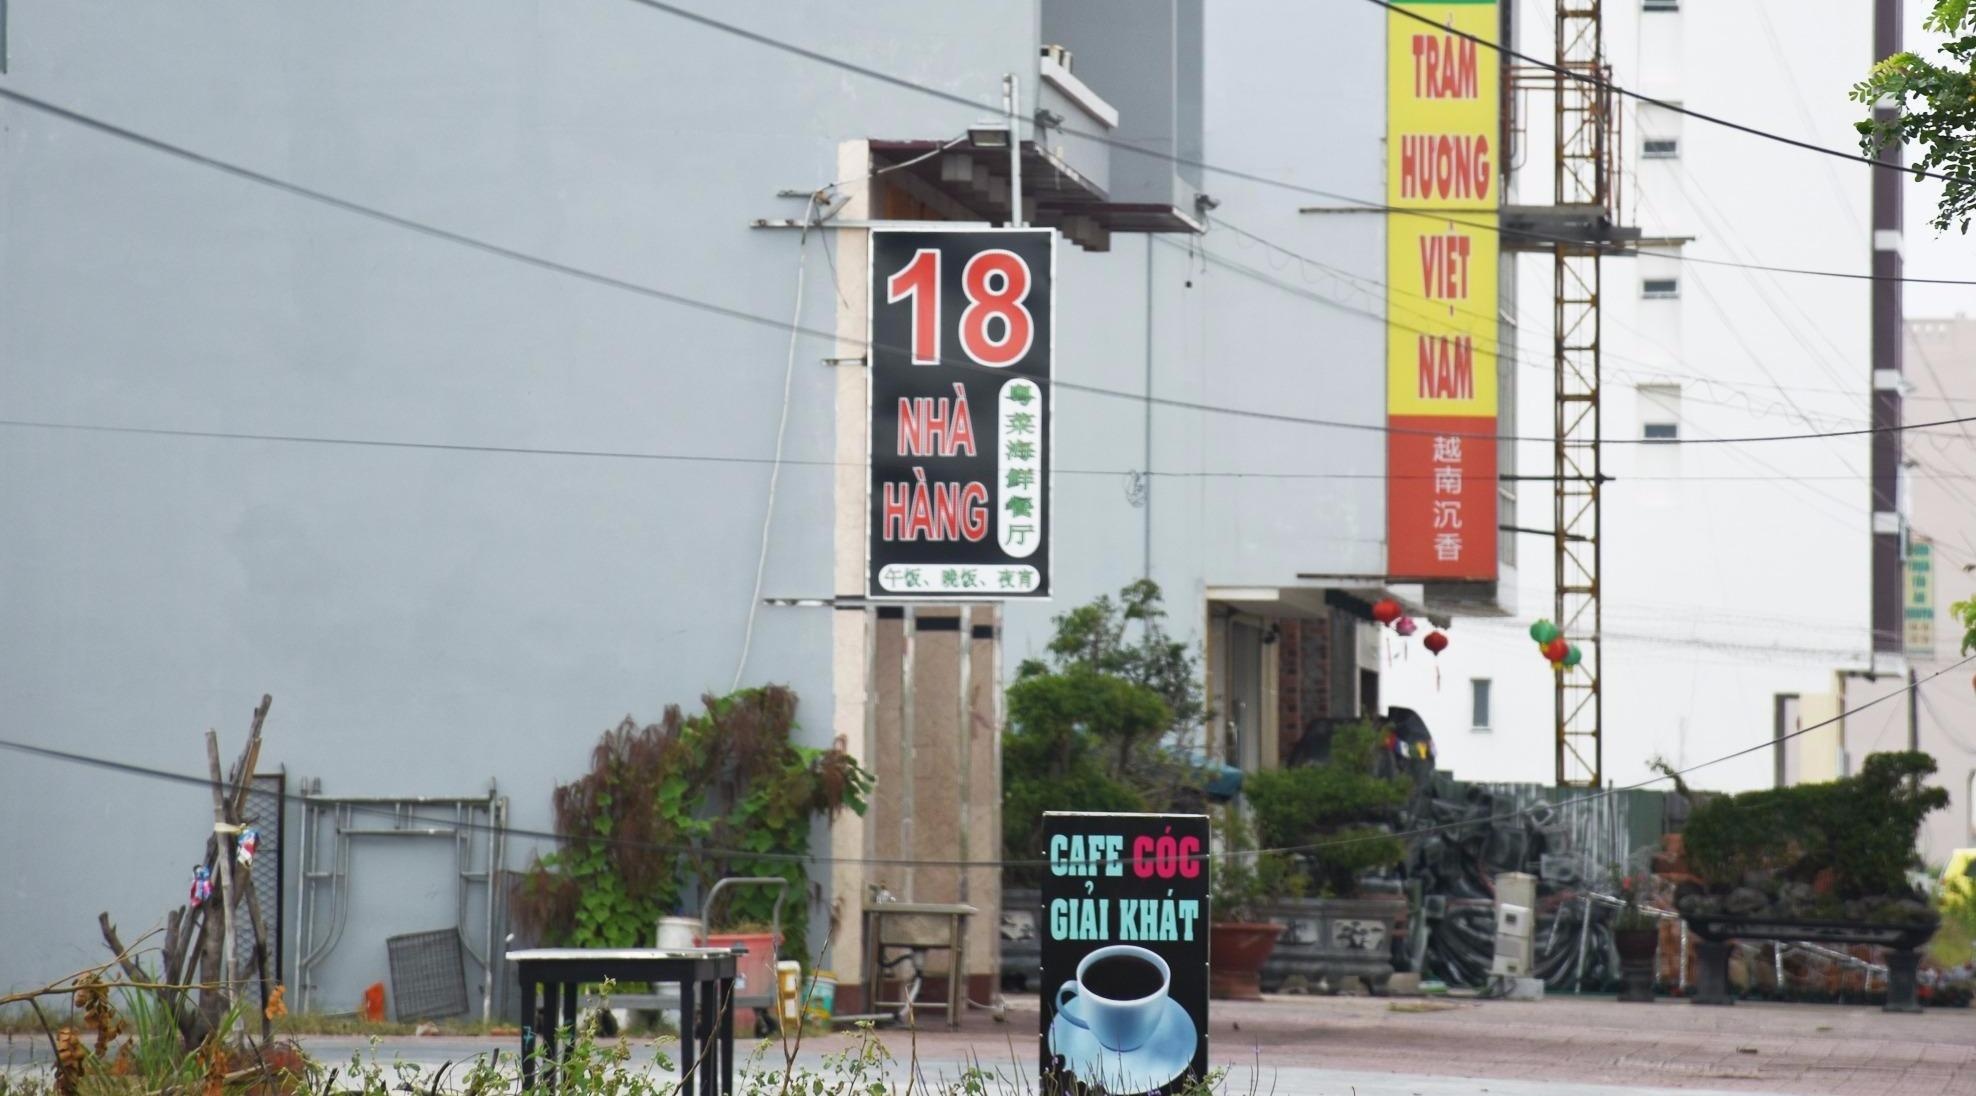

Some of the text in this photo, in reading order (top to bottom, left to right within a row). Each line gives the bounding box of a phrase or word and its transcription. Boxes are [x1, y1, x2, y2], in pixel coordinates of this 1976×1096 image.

[1419, 219, 1471, 317] VIỆT
[887, 248, 1035, 368] 18
[1418, 335, 1474, 400] NAM
[897, 382, 977, 457] NHÀ
[882, 466, 989, 542] HÀNG
[1432, 435, 1463, 562] 越南沉香
[1050, 826, 1200, 879] CAFE CÓC
[1050, 880, 1199, 942] GIẢI KHÁT
